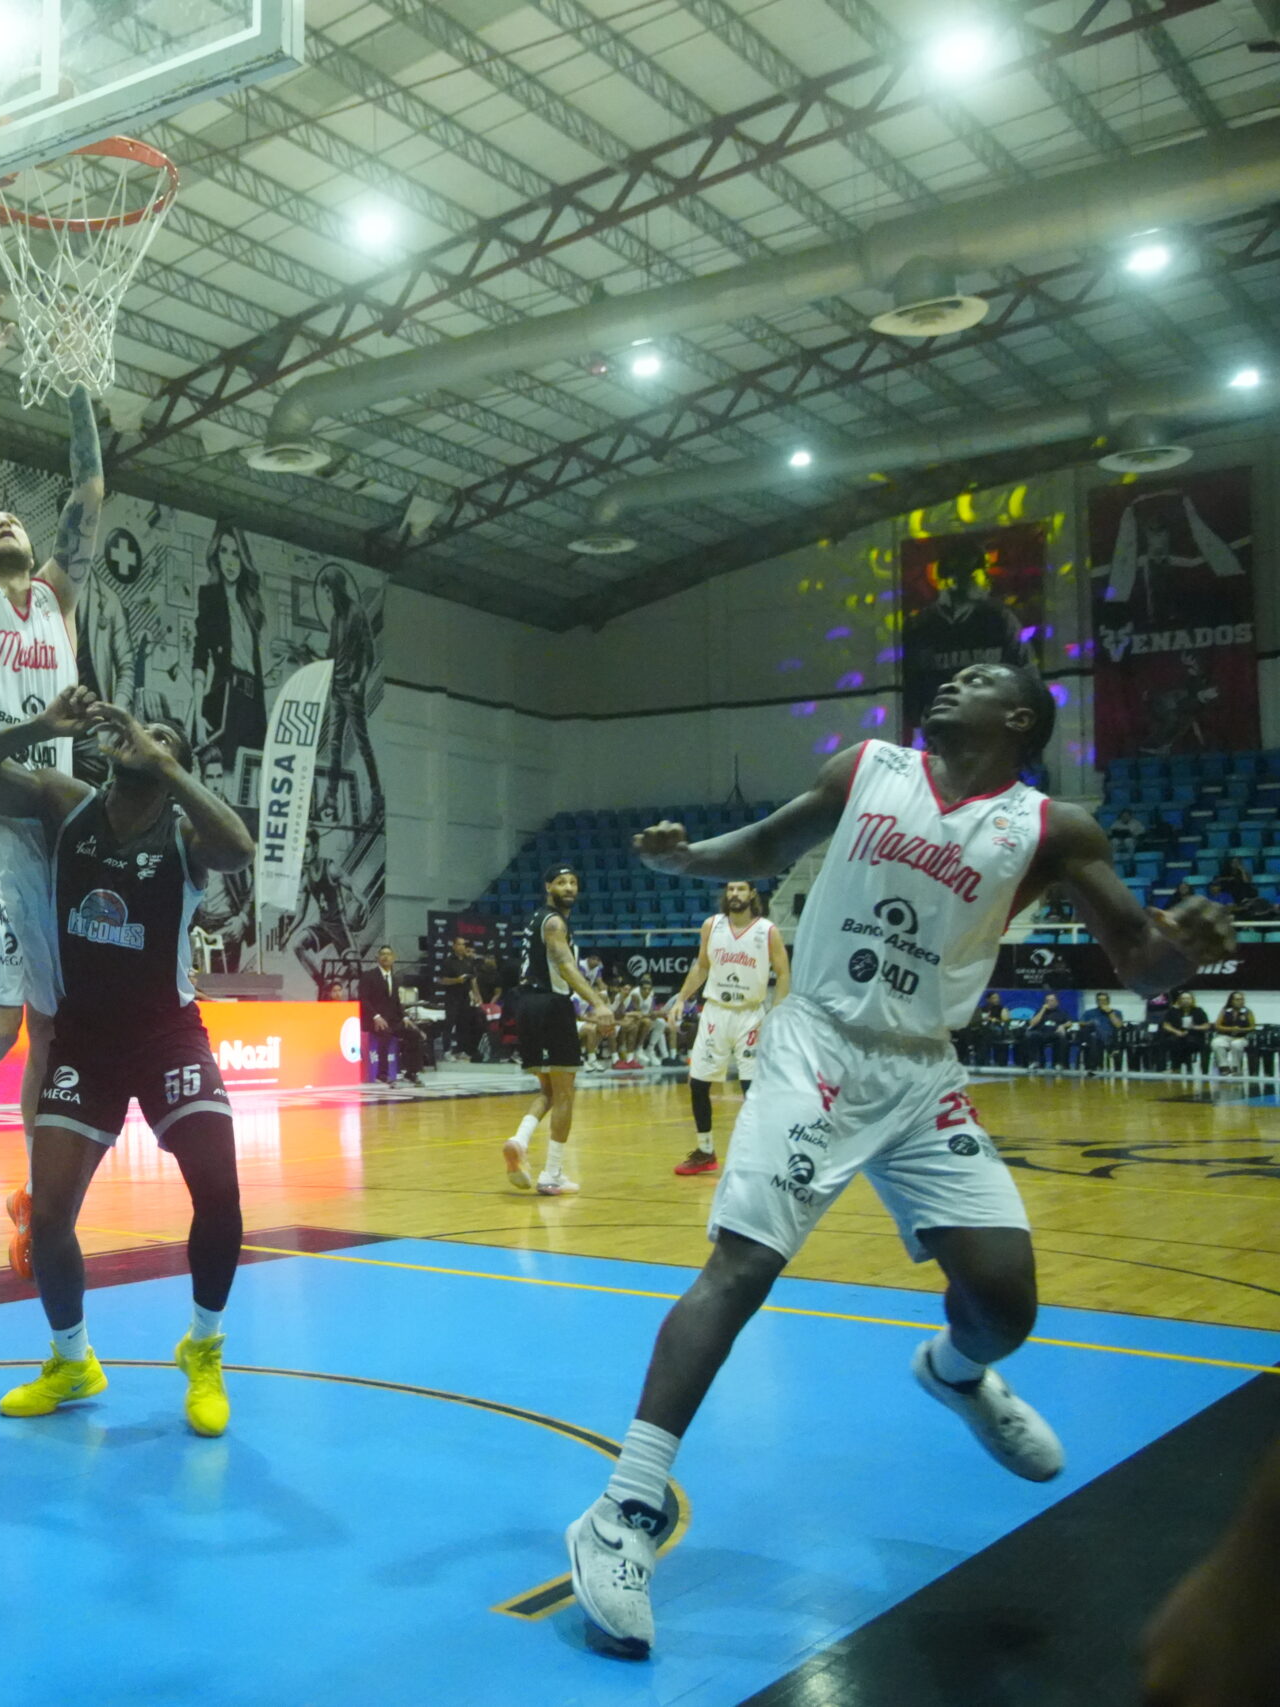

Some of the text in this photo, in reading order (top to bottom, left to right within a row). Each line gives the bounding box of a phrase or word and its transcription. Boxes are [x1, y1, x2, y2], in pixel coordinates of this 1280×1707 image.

[264, 754, 296, 862] HERSA
[884, 933, 941, 966] Azteca
[41, 1087, 81, 1104] MEGA
[164, 1064, 201, 1104] 55
